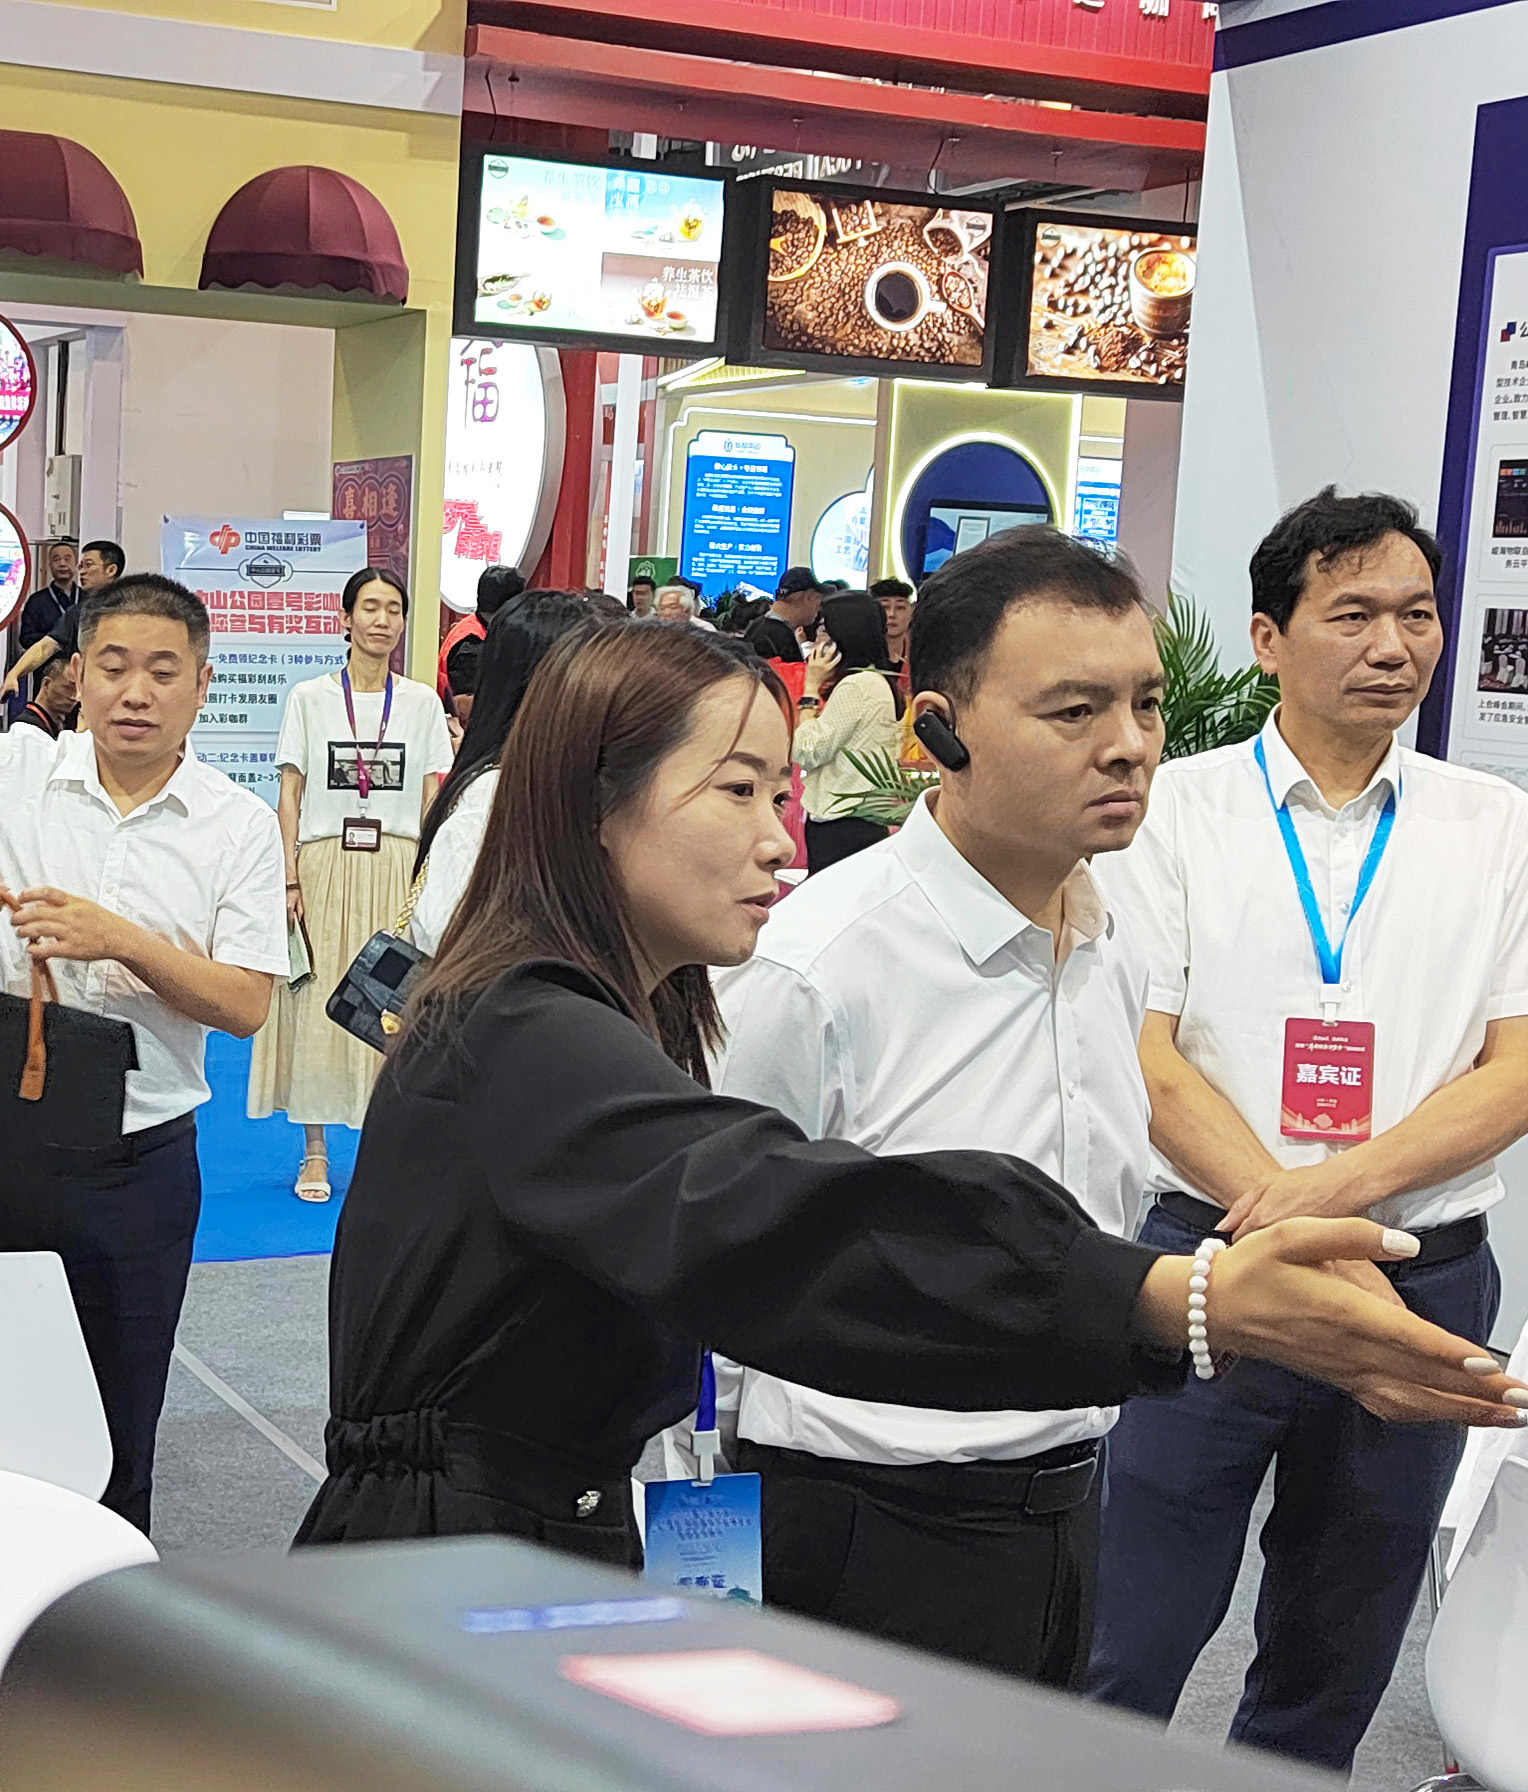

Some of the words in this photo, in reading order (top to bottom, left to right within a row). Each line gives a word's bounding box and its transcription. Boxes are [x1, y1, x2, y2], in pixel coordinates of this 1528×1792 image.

[662, 266, 714, 284] 养生茶饮
[1511, 360, 1528, 370] 青岛
[1496, 376, 1528, 388] 型技术企
[245, 532, 322, 546] 中国福利彩票
[210, 612, 342, 634] 您参与有奖互动
[204, 693, 278, 705] 照打卡发朋友圈
[198, 713, 248, 724] 加入彩咖群
[1296, 1063, 1362, 1086] 嘉宾证
